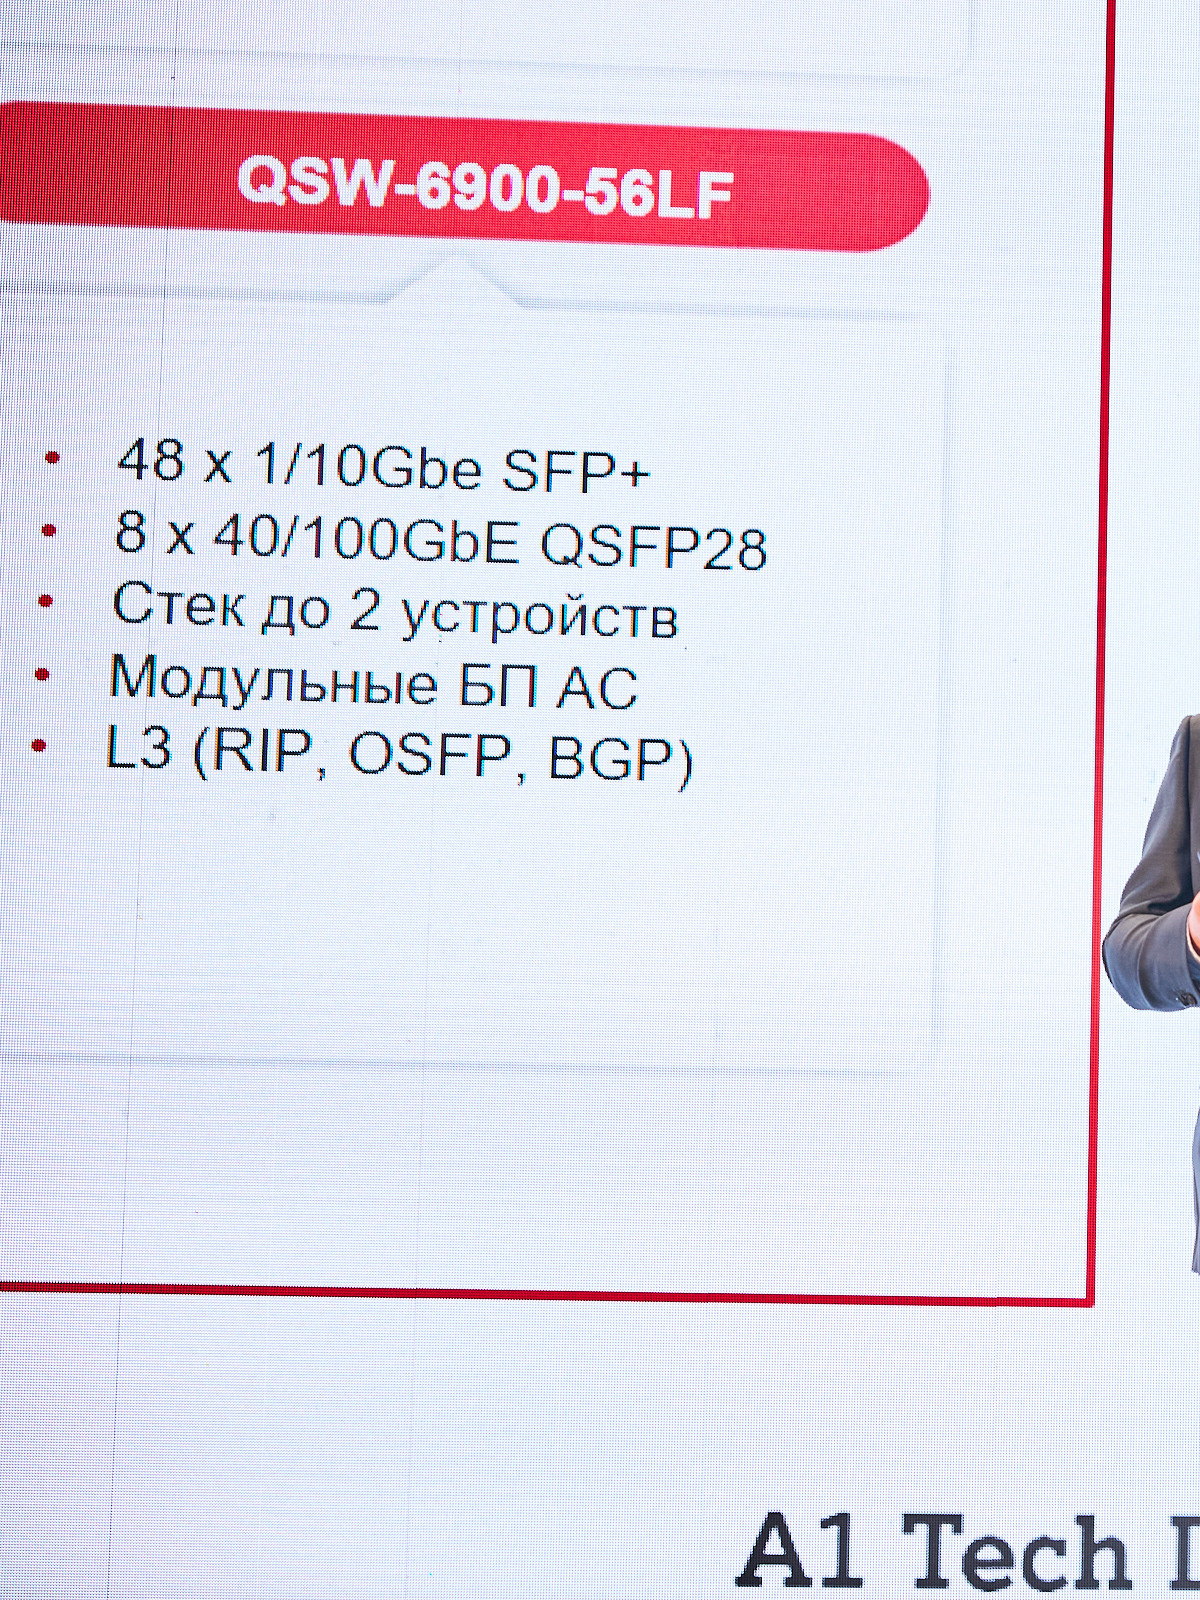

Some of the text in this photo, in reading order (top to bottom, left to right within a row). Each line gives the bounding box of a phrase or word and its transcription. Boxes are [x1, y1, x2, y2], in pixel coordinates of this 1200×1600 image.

[237, 153, 736, 222] QSW-6900-56LF
[117, 437, 651, 494] 48 x 1/10Gbe SFP+
[115, 509, 768, 571] 8 x 40/100GbE QSFP28
[113, 580, 679, 643] Стек до 2 устройств
[110, 653, 438, 710] Модульные
[460, 662, 537, 708] БП
[107, 724, 693, 792] L3 (RIP, OSFP, BGP)
[734, 1511, 864, 1589] A1
[902, 1512, 1133, 1593] Tech
